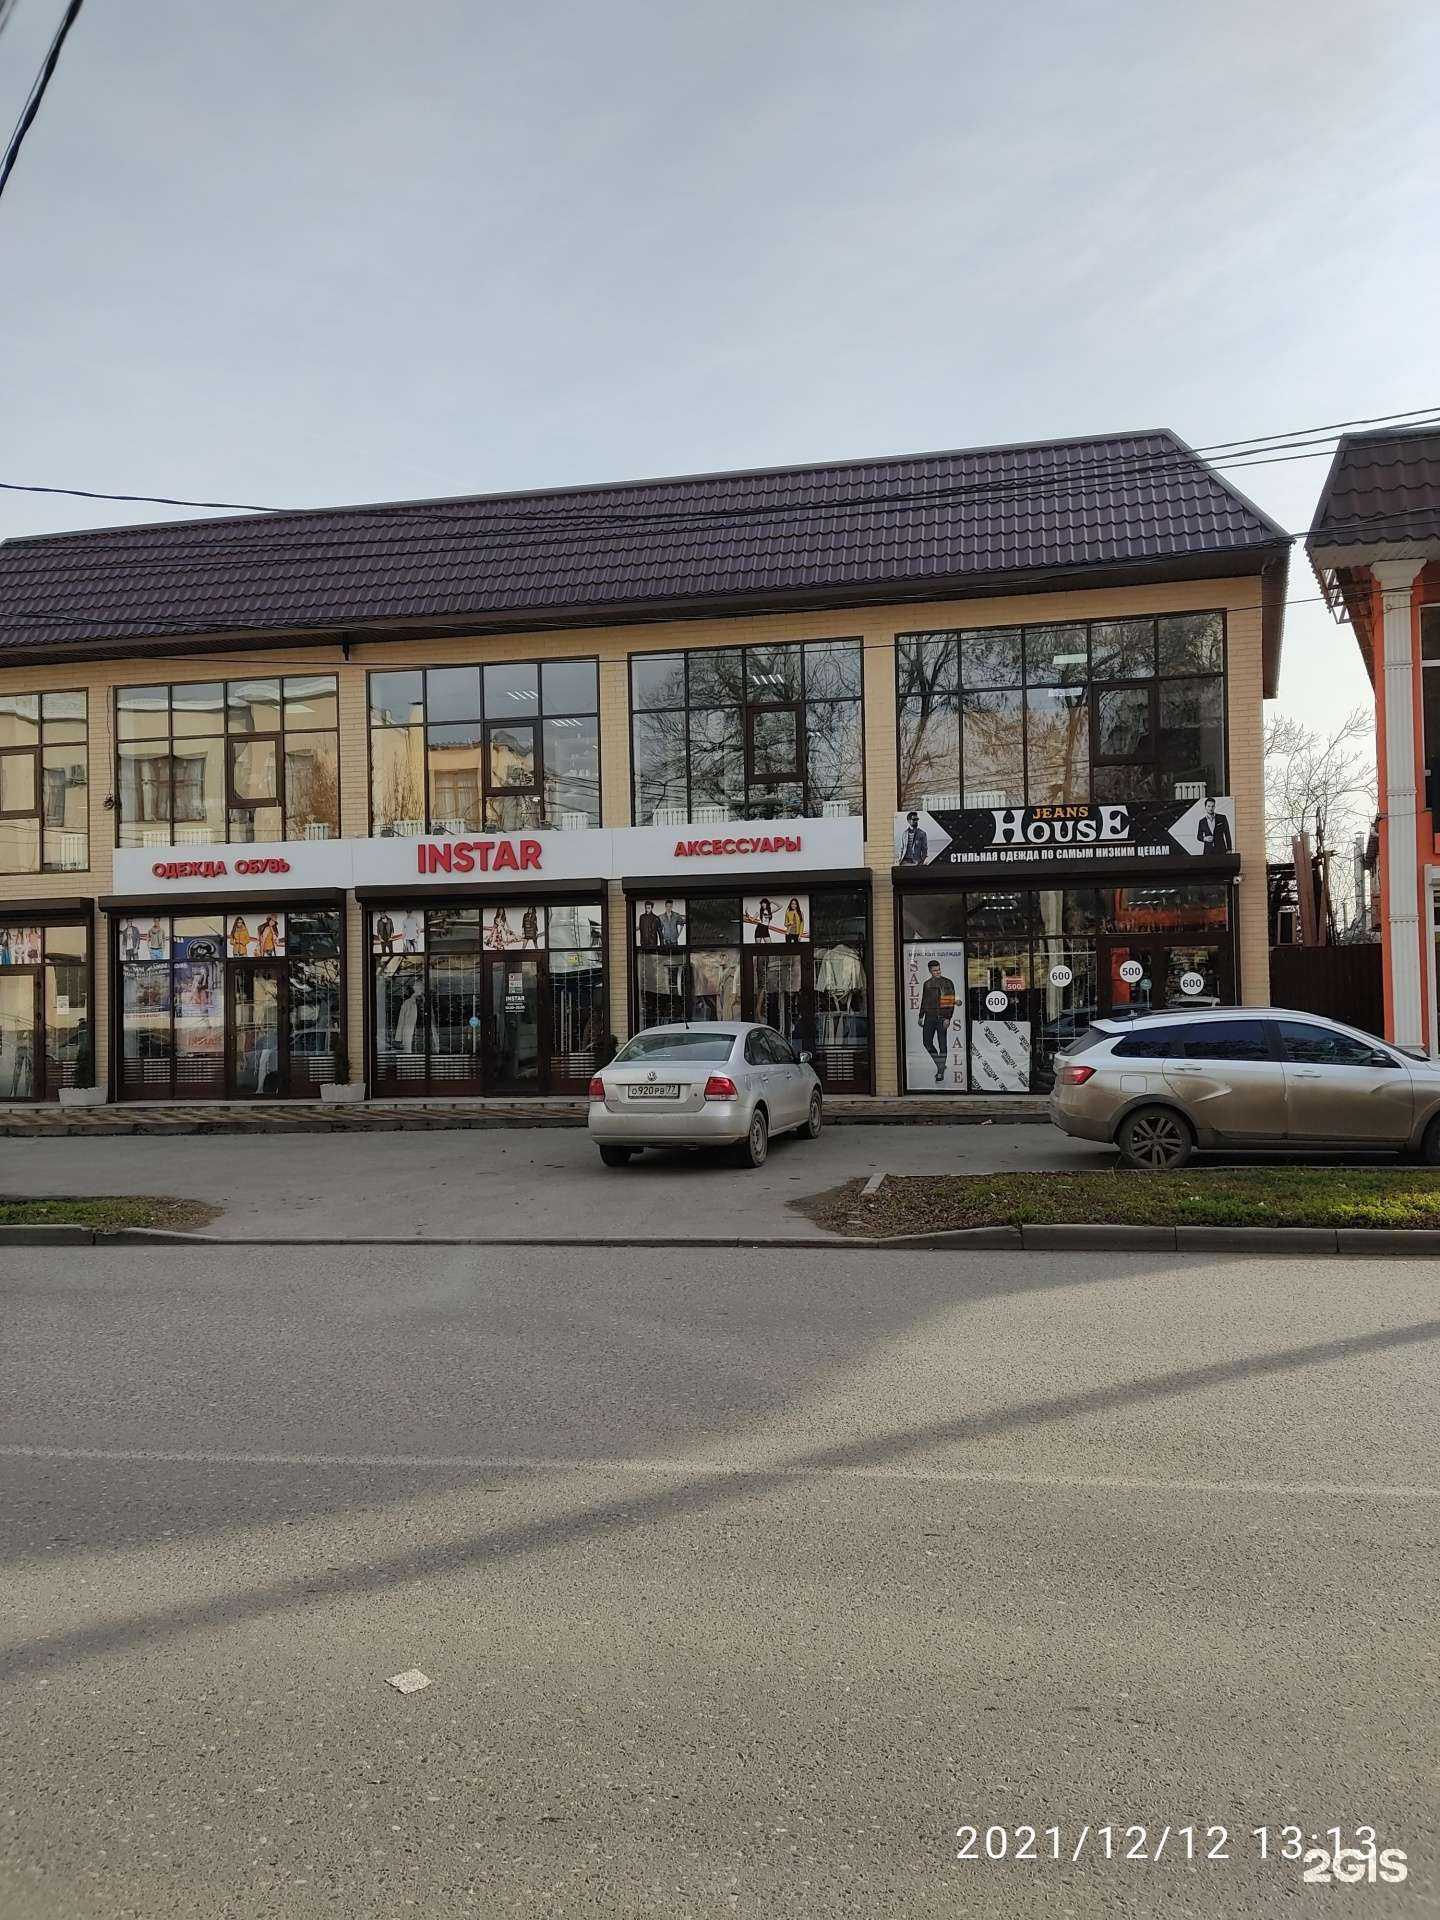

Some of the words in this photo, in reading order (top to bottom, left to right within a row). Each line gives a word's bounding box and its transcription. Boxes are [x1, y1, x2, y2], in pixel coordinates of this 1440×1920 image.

[1033, 806, 1089, 820] JEANS
[990, 804, 1130, 845] HOUSE
[674, 835, 802, 857] АКСЕССУАРЫ
[950, 851, 998, 863] СТИЛЬНАЯ
[1000, 849, 1040, 863] ОДЕЖДА
[1041, 849, 1053, 860] ПО
[1056, 848, 1094, 860] САМЫМ
[1096, 846, 1135, 858] НИЗКИМ
[1138, 845, 1170, 858] ЦЕНАМ
[417, 839, 542, 874] INSTAR
[152, 860, 228, 880] ОДЕЖДА
[234, 857, 291, 875] ОБУВЬ
[1052, 972, 1070, 981] 600
[1122, 967, 1141, 976] 500
[909, 960, 920, 1010] SALE
[1182, 979, 1202, 988] 600
[988, 997, 1006, 1006] 600
[952, 1020, 963, 1084] SALE
